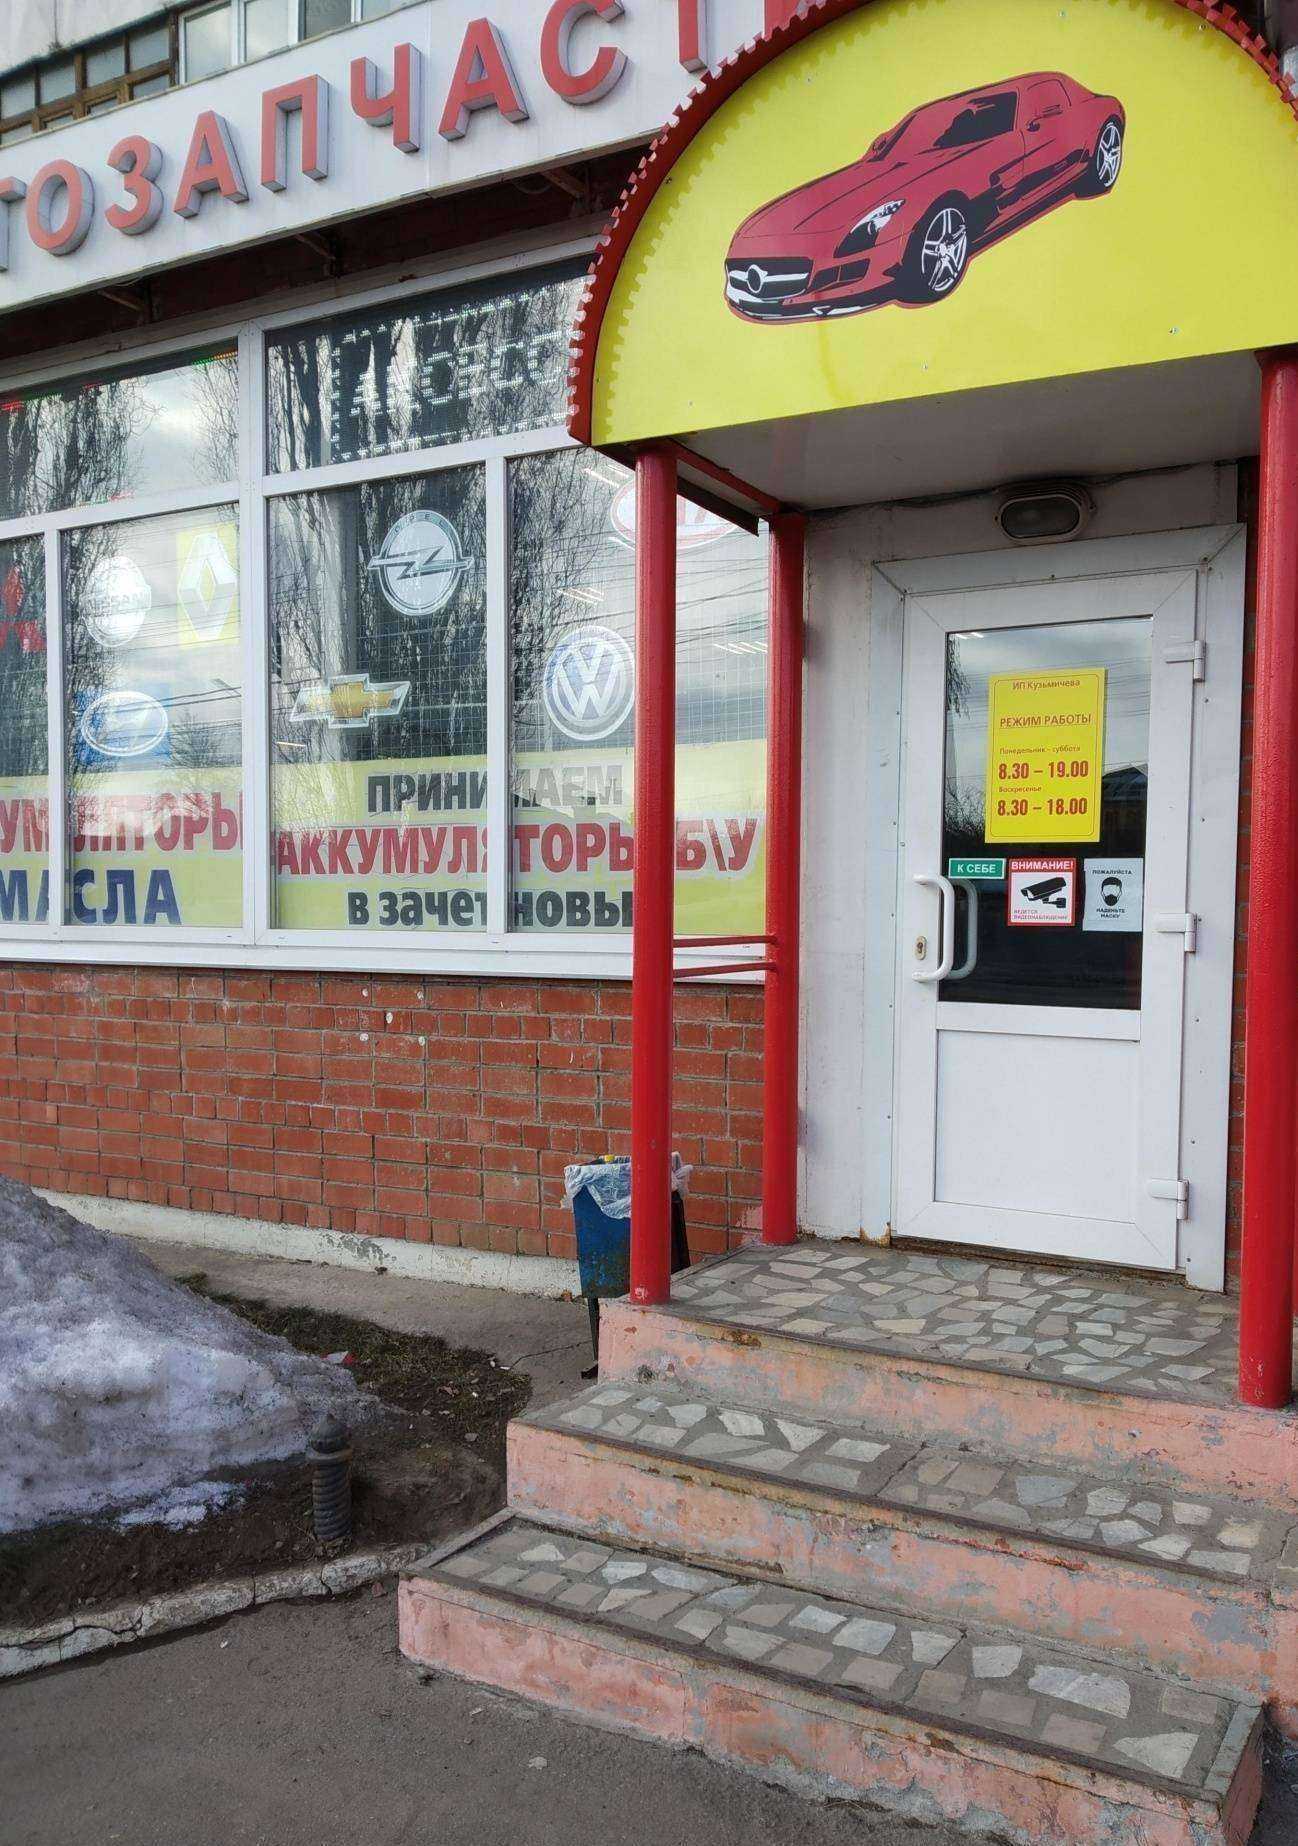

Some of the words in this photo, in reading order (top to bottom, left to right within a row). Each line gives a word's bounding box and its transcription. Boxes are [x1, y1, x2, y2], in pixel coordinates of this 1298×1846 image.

[1013, 682, 1025, 690] ИП
[1000, 716, 1041, 727] РЕЖИМ
[1045, 714, 1091, 725] РАБОТЫ
[999, 763, 1029, 779] 8.30
[1048, 760, 1089, 778] 19.00
[997, 799, 1028, 816] 8.30
[1047, 797, 1088, 815] 18.00
[278, 822, 634, 874] АККУМУЛТОР
[957, 864, 963, 873] К
[966, 864, 996, 873] СЕБЕ
[1011, 861, 1074, 871] ВНИМАНИЕ!
